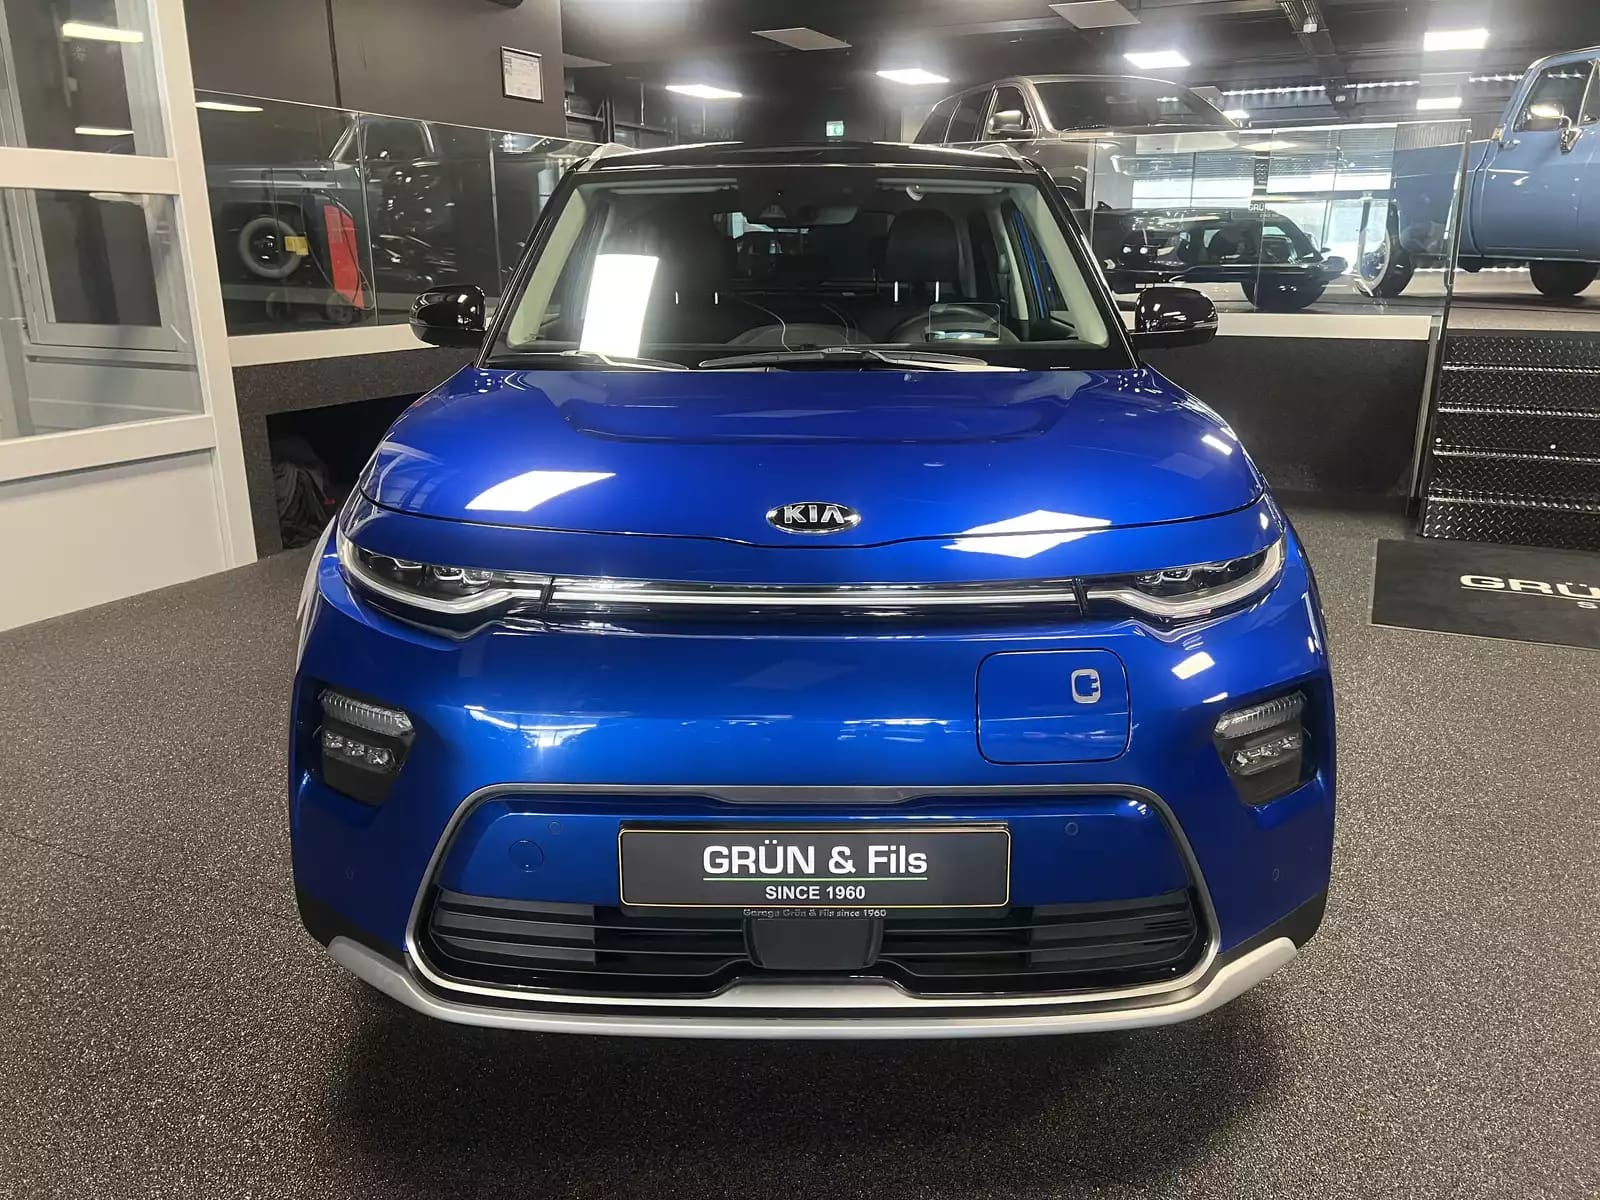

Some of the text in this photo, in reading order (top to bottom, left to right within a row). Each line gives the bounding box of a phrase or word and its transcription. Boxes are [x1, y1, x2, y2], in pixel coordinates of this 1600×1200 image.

[783, 504, 845, 524] KIA
[703, 839, 928, 874] GRÜN & Fils
[765, 885, 866, 900] SINCE 1960
[743, 908, 780, 918] Garage
[782, 908, 807, 917] Grün
[836, 909, 860, 917] since
[863, 909, 887, 917] 1960
